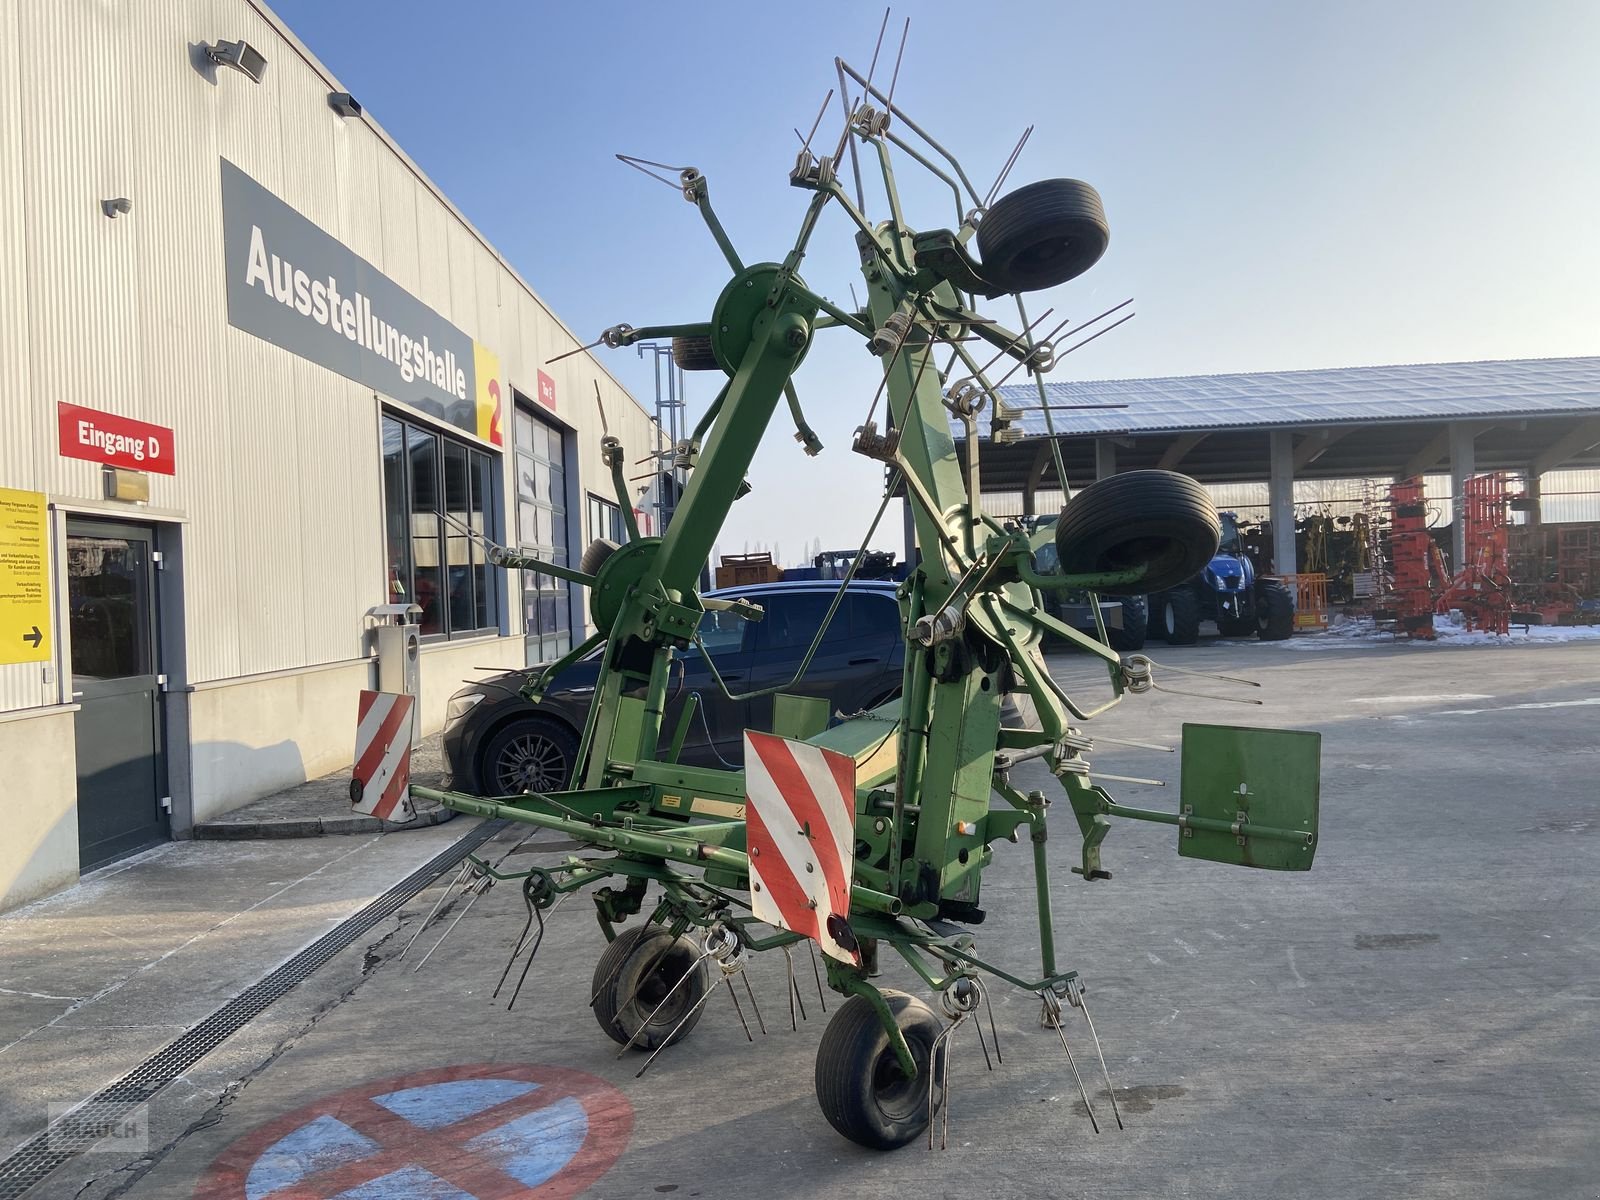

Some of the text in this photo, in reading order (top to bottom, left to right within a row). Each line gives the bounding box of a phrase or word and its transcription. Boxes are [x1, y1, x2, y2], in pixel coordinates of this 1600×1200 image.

[246, 224, 503, 448] Ausstellungshalle 2
[78, 420, 160, 461] Eingang D
